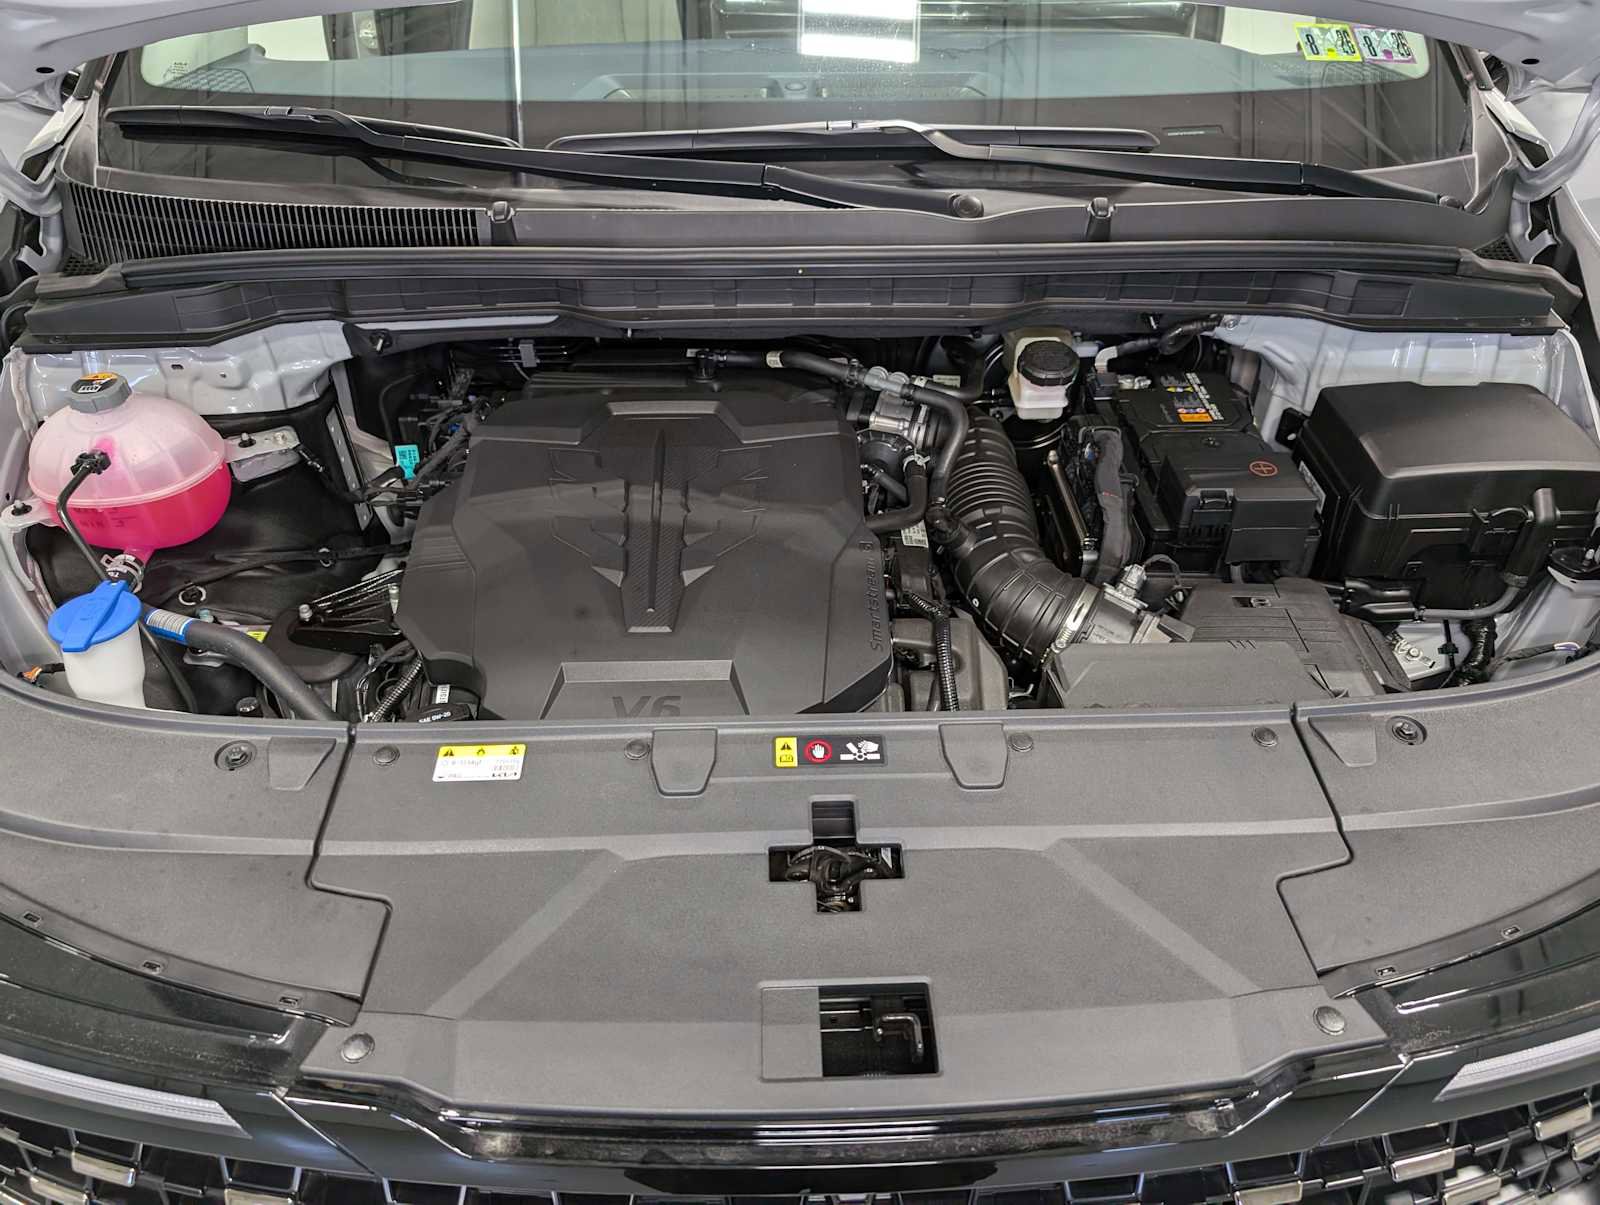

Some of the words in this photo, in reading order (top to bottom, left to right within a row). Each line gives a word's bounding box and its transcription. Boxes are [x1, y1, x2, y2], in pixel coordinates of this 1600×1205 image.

[1305, 33, 1320, 55] 8
[1363, 35, 1378, 56] 8
[612, 695, 681, 718] V6
